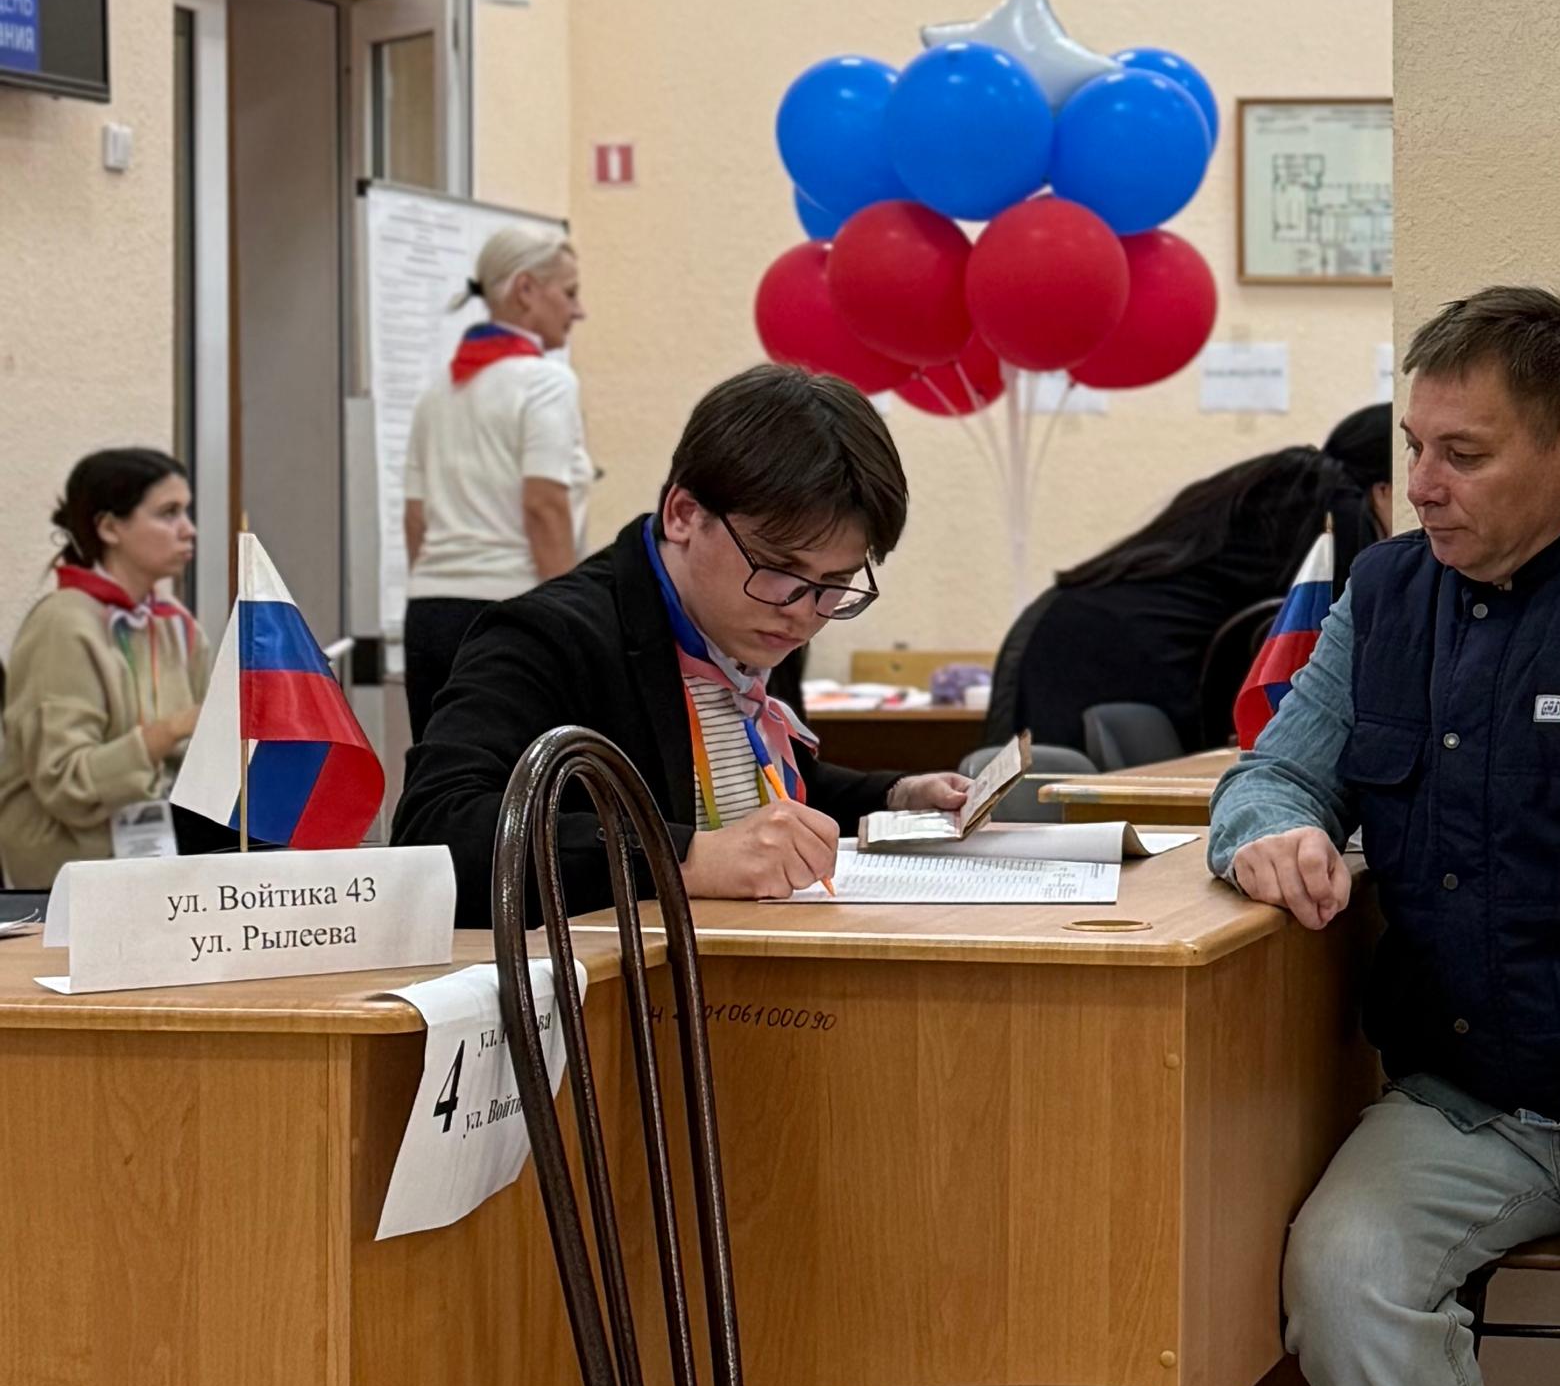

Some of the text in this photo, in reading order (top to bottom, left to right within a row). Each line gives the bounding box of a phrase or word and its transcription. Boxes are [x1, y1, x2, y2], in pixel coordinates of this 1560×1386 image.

[167, 876, 377, 921] ул. Войтика 43
[190, 924, 357, 962] ул. Рылеева
[433, 1039, 466, 1133] 4
